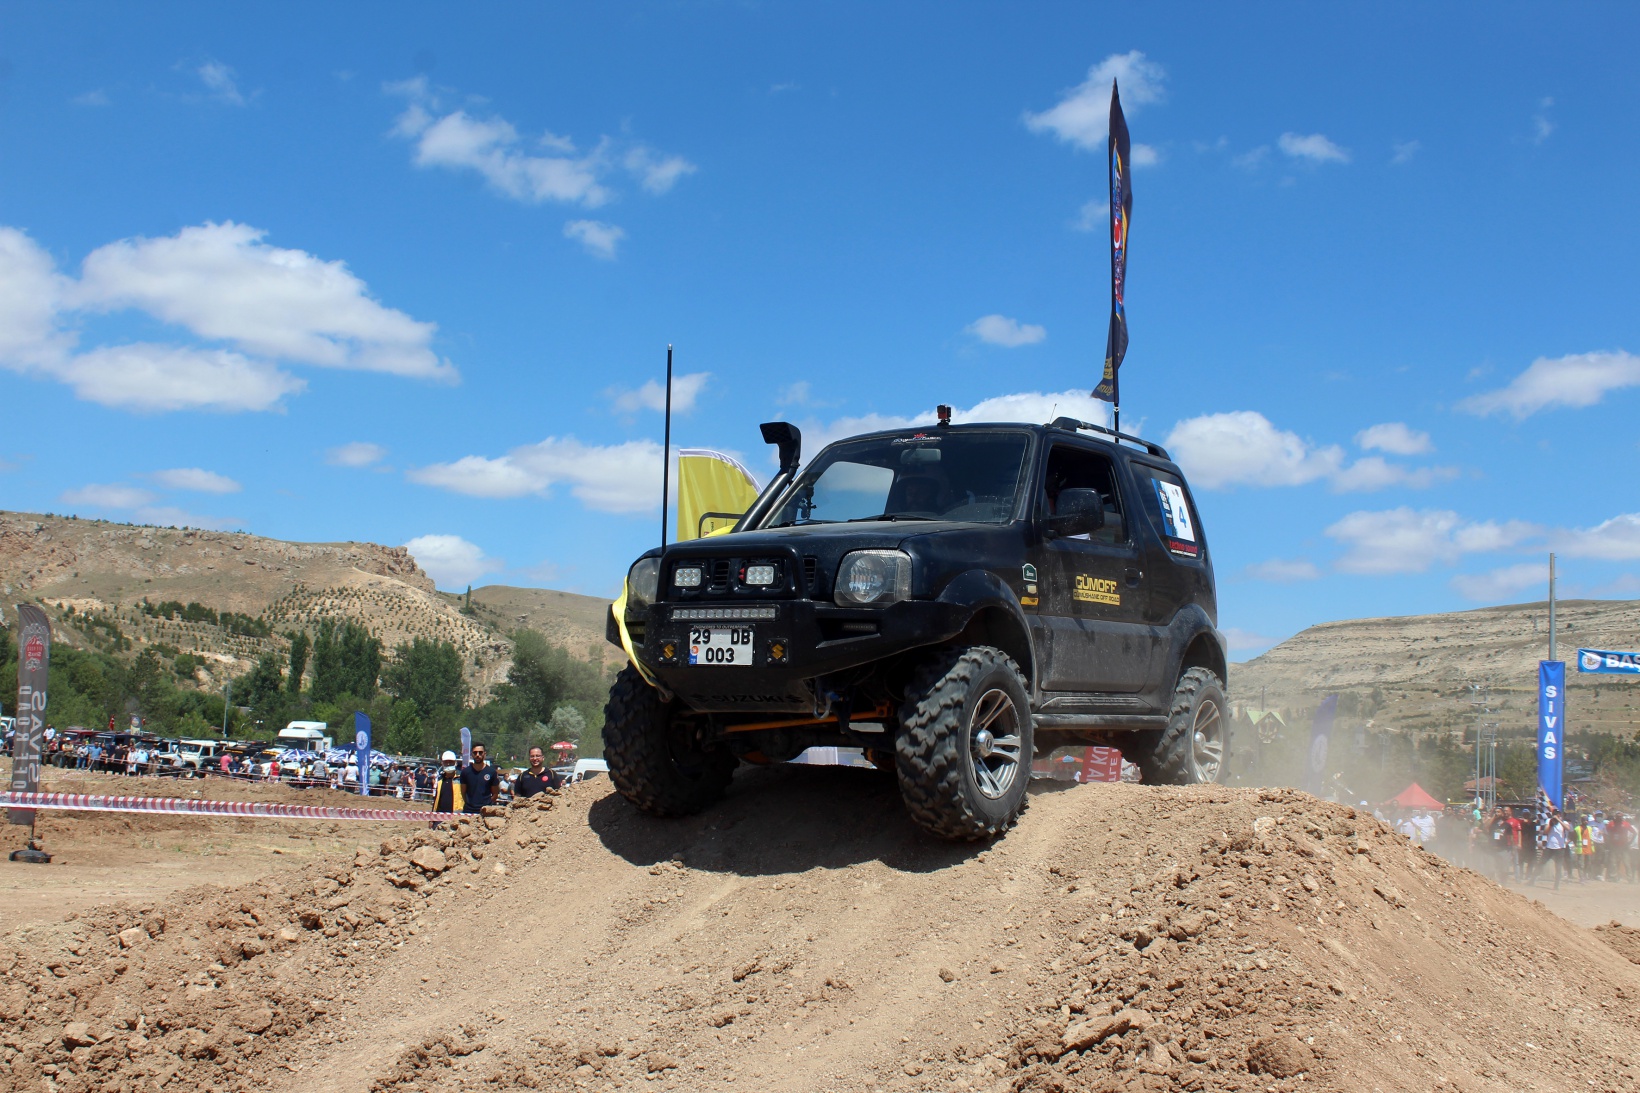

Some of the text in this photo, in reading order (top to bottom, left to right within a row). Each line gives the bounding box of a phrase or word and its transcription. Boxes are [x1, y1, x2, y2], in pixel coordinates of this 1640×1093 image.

[1179, 506, 1187, 528] 4
[1075, 573, 1117, 593] GÜMOFF
[692, 629, 751, 645] 29 DB
[705, 647, 735, 663] 003
[712, 694, 784, 703] SUZUKI
